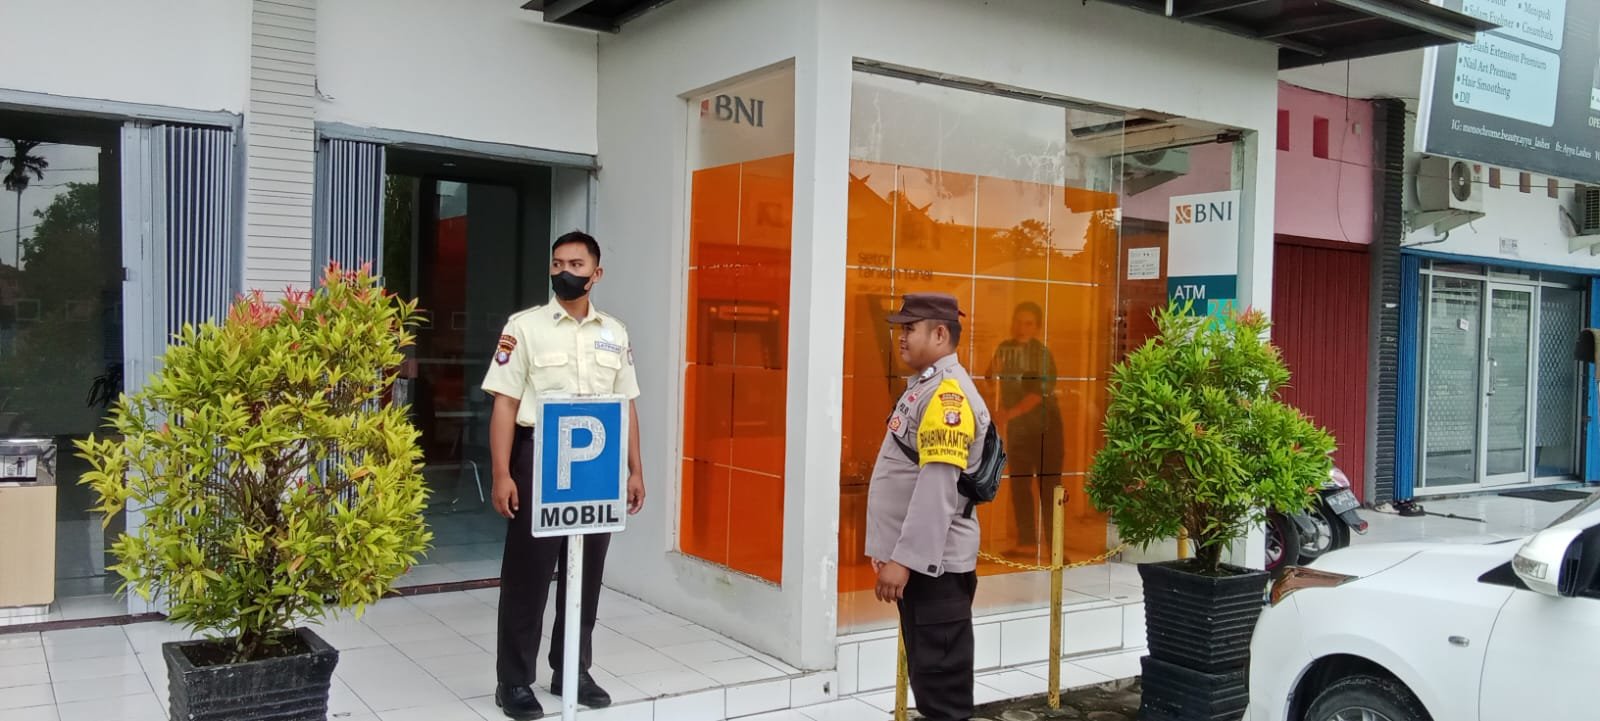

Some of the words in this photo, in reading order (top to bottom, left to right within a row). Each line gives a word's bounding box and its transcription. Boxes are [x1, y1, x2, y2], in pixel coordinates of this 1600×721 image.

[1463, 56, 1477, 70] Nail
[1477, 61, 1489, 73] Art
[1489, 63, 1517, 81] Premium
[1490, 44, 1520, 63] Extension
[1520, 53, 1547, 70] Premium
[1461, 73, 1476, 88] Hair
[1476, 77, 1512, 101] Smoothing
[715, 94, 764, 127] BNI
[1451, 119, 1462, 131] IG:
[1195, 201, 1232, 223] BNI
[1174, 285, 1206, 300] ATM
[557, 415, 606, 490] P
[540, 504, 619, 527] MOBIL
